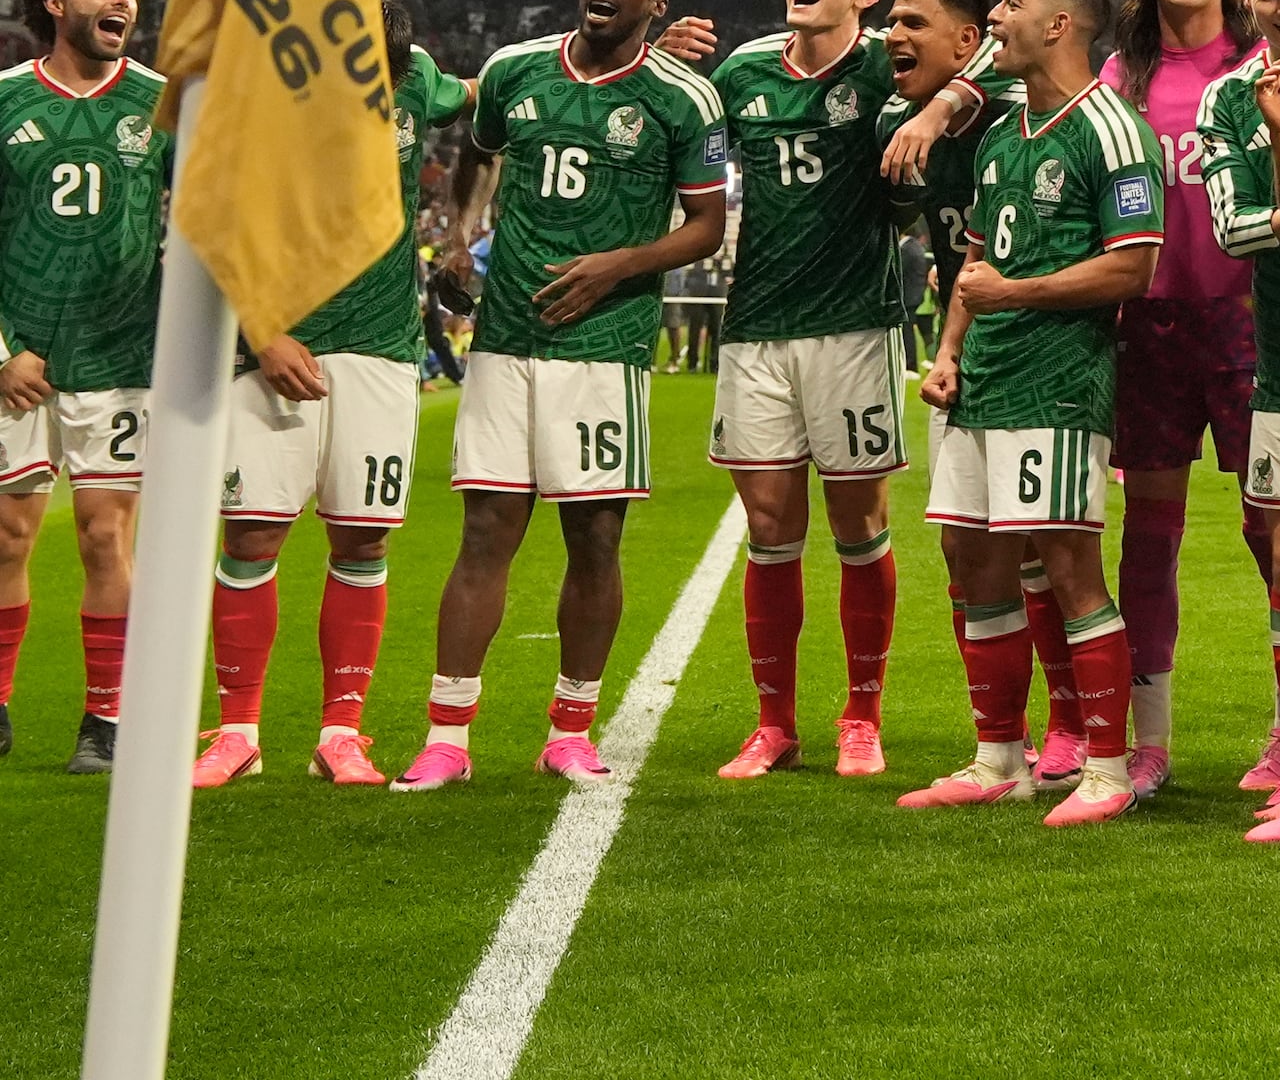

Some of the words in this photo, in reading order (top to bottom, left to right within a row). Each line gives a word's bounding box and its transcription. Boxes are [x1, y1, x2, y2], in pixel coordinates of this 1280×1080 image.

[540, 144, 589, 200] 16
[774, 133, 823, 186] 15
[1161, 131, 1203, 186] 12
[52, 163, 100, 216] 21
[939, 206, 973, 253] 2
[994, 205, 1016, 259] 6
[110, 410, 149, 462] 2
[576, 421, 622, 471] 16
[843, 404, 889, 457] 15
[365, 455, 401, 507] 18
[1019, 450, 1042, 503] 6
